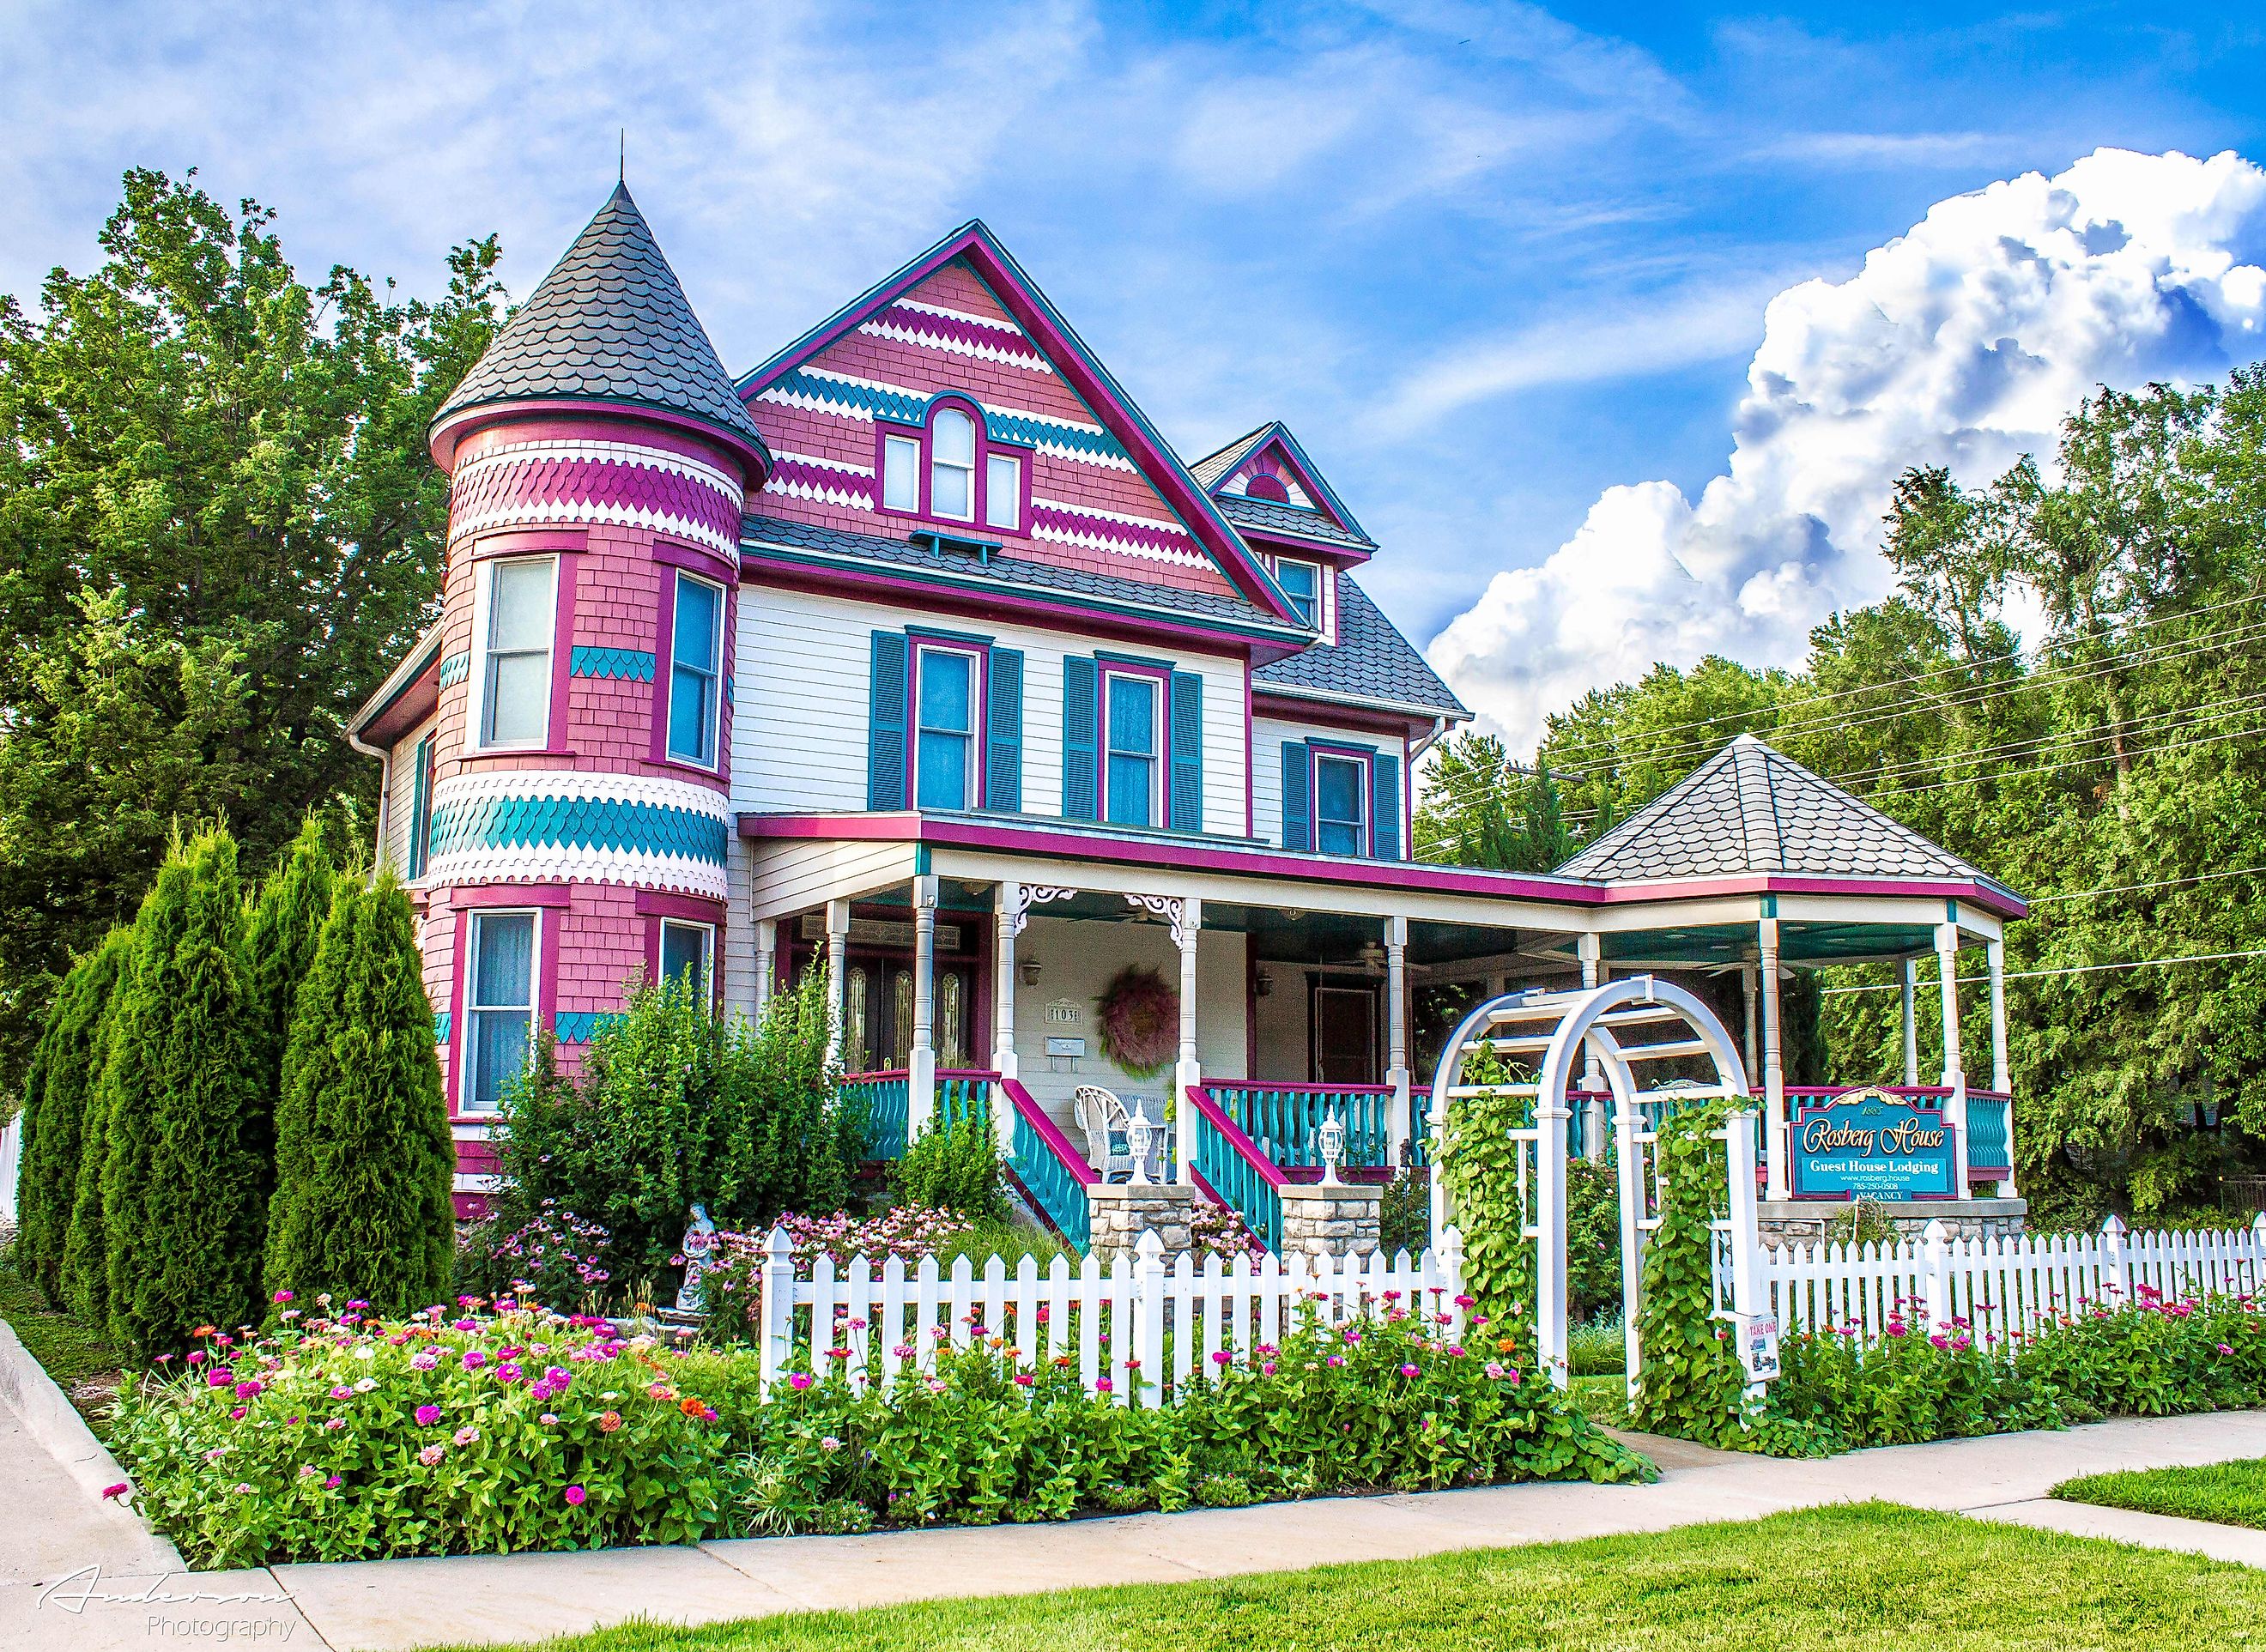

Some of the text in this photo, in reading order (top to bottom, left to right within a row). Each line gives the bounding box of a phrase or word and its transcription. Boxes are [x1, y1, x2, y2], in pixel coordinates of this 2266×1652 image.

[1055, 1009, 1073, 1020] 103
[1802, 1117, 1945, 1157] Rosberg House
[1809, 1159, 1939, 1175] Guest House Lodging
[1839, 1174, 1911, 1183] www.rosberg.house
[1749, 1322, 1776, 1336] TAKE ONE
